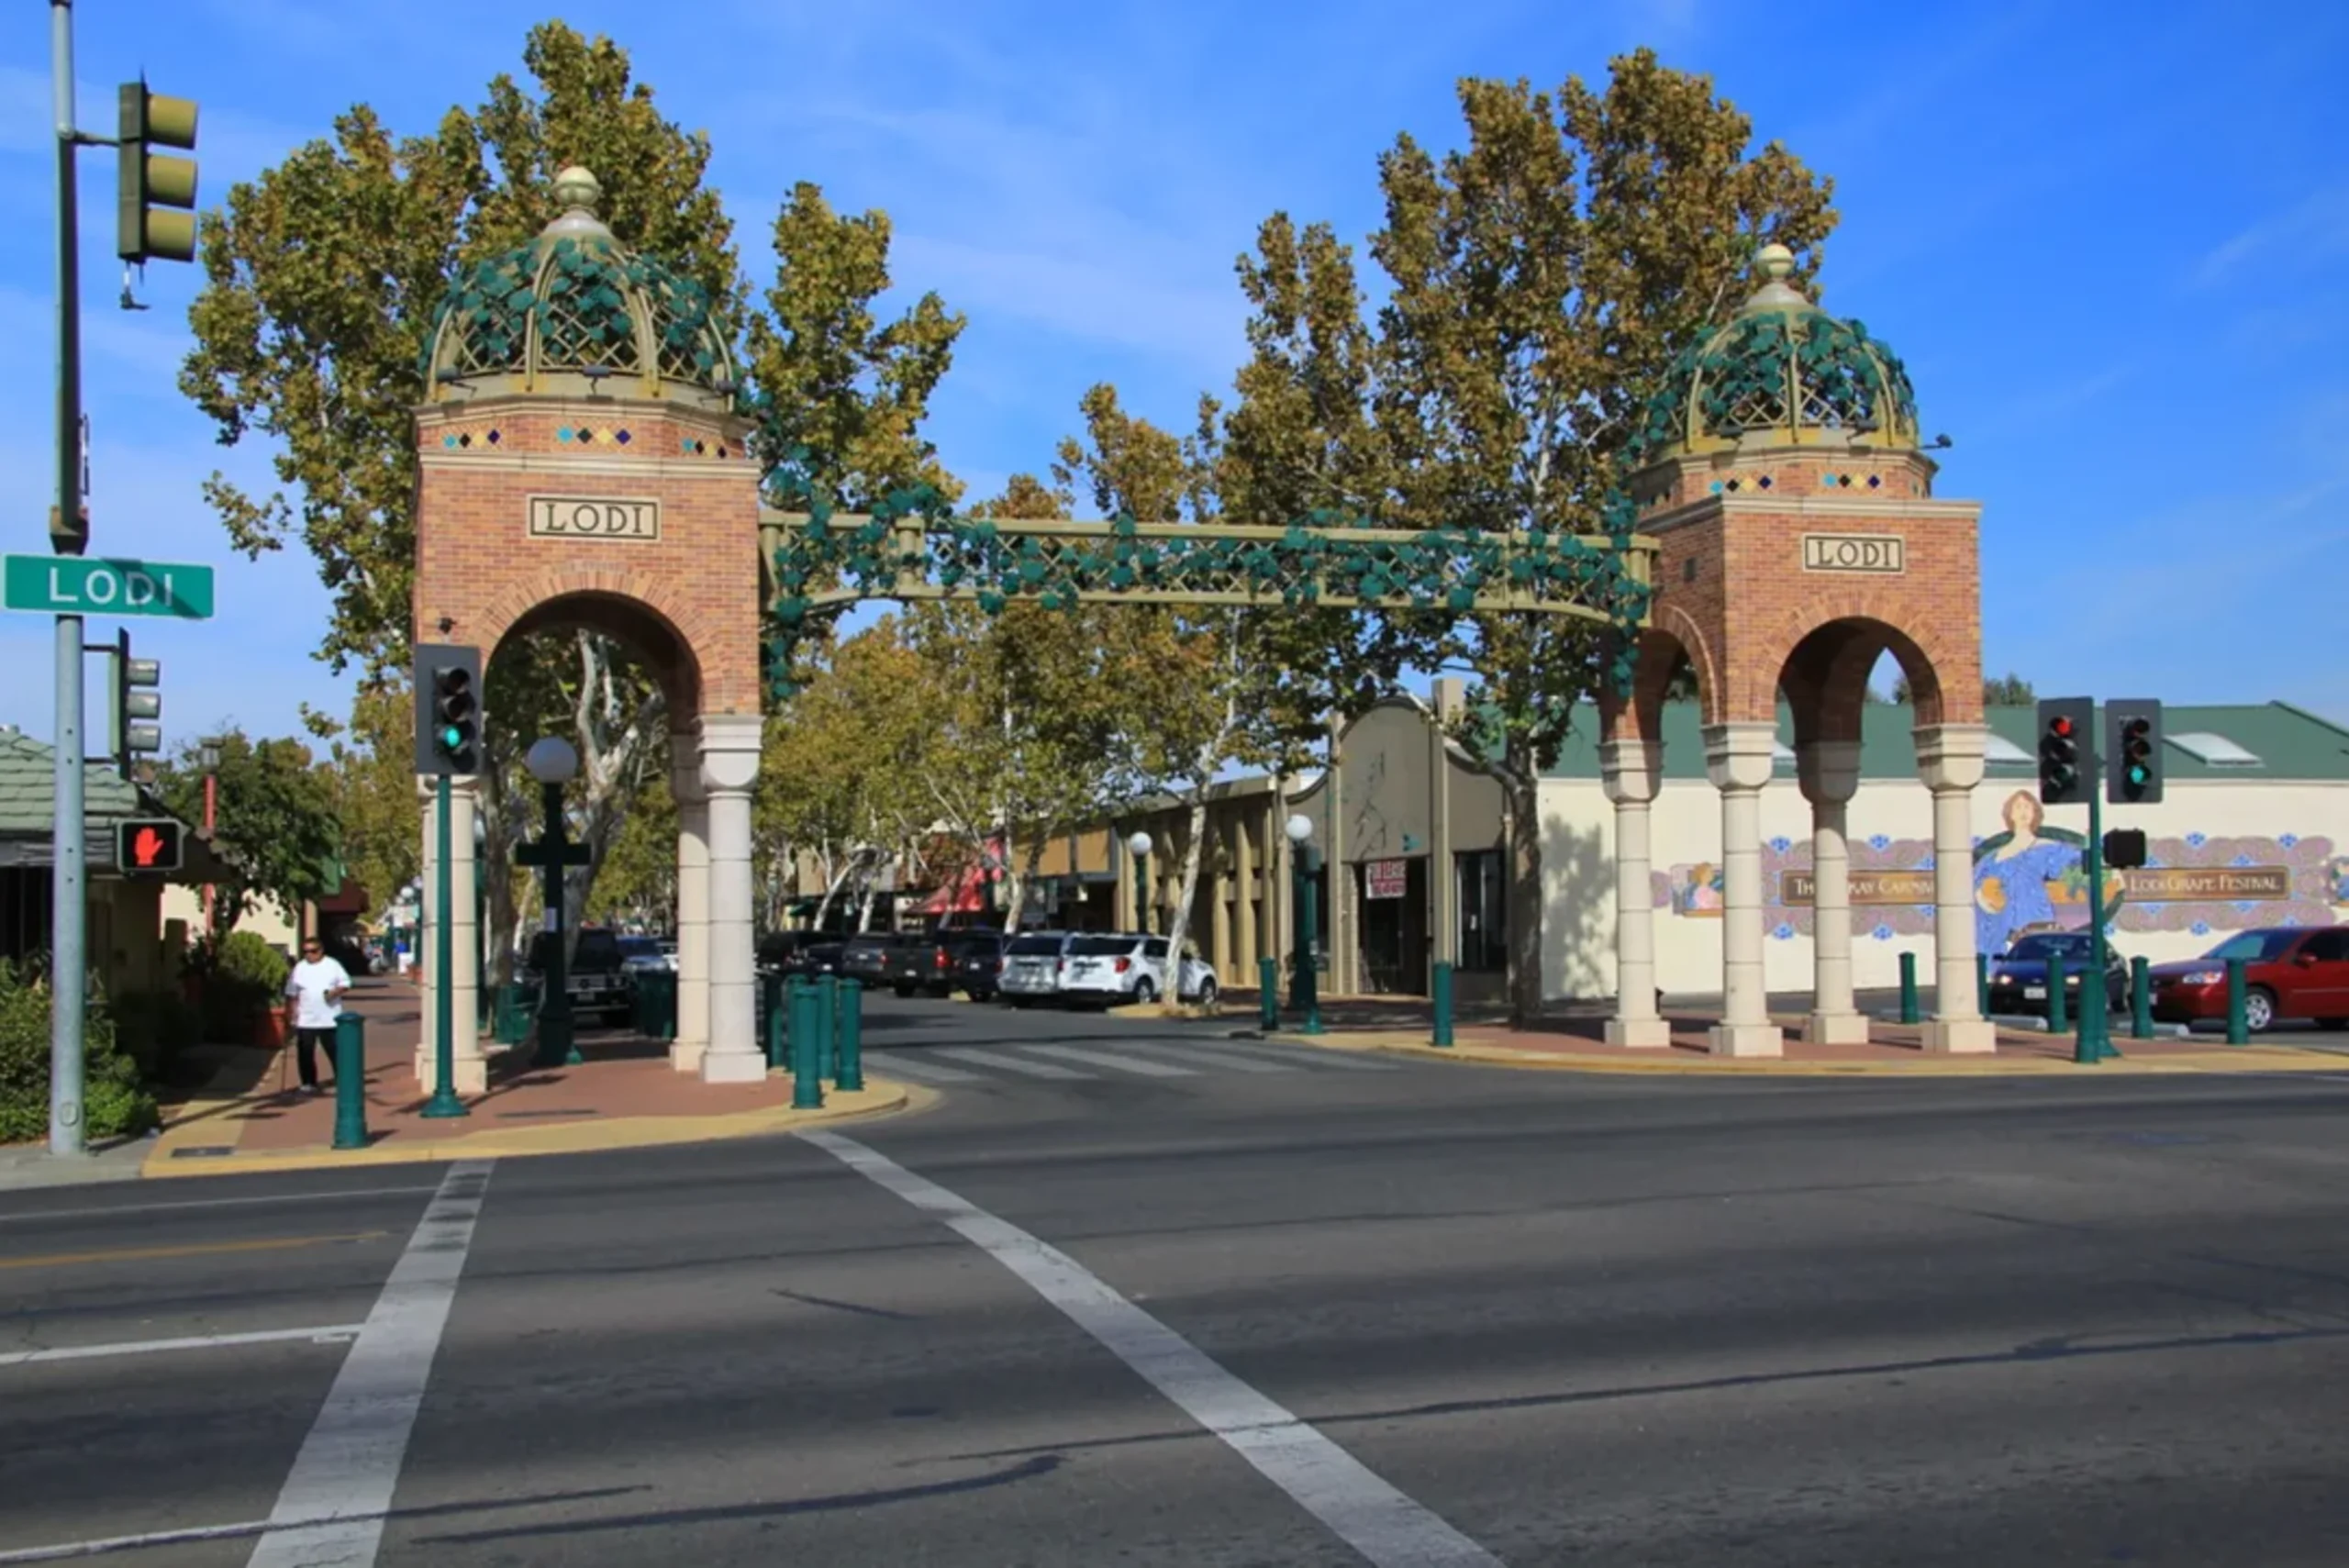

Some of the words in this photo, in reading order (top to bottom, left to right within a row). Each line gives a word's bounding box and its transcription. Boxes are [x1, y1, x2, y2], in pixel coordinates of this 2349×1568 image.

[545, 502, 643, 534] LODI
[1816, 539, 1891, 567] LODI
[49, 566, 173, 607] LODI
[1794, 878, 1815, 895] TH
